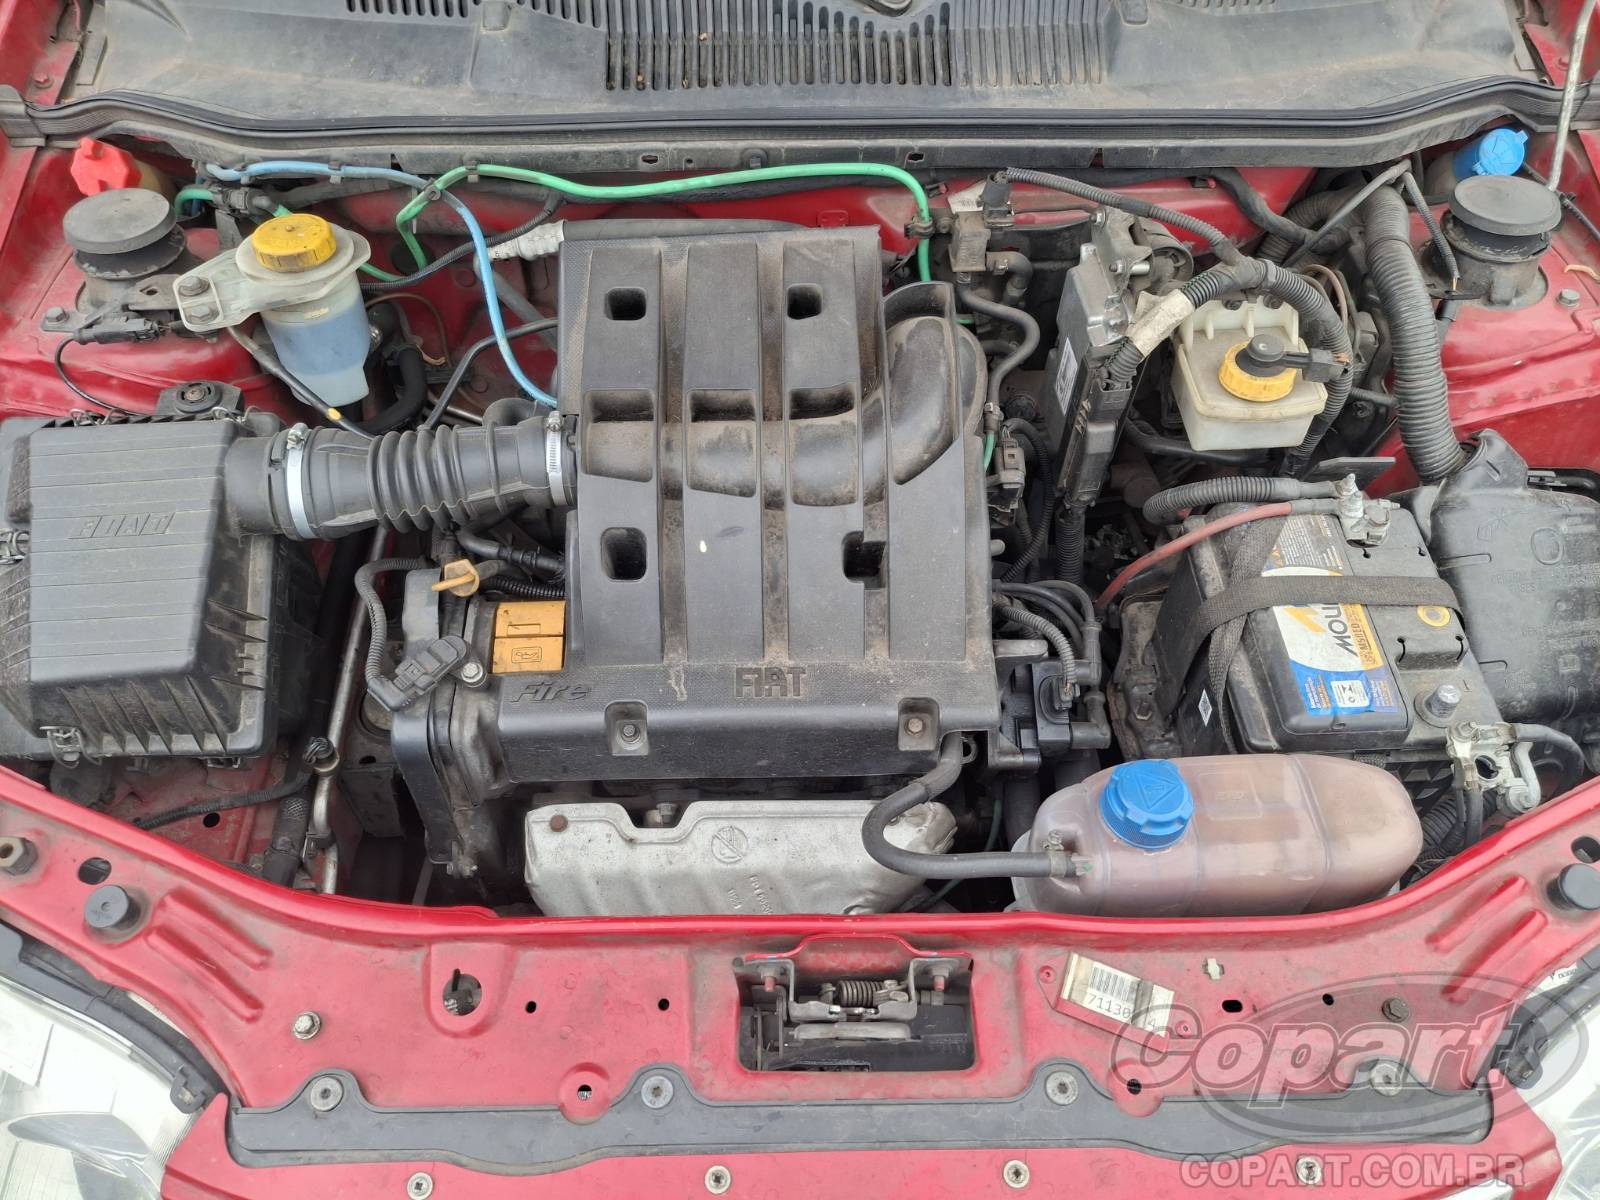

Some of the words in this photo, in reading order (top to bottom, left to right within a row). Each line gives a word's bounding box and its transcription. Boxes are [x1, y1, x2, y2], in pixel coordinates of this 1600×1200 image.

[1321, 603, 1359, 657] MOU
[510, 681, 589, 703] Fire
[735, 666, 807, 698] FIAT
